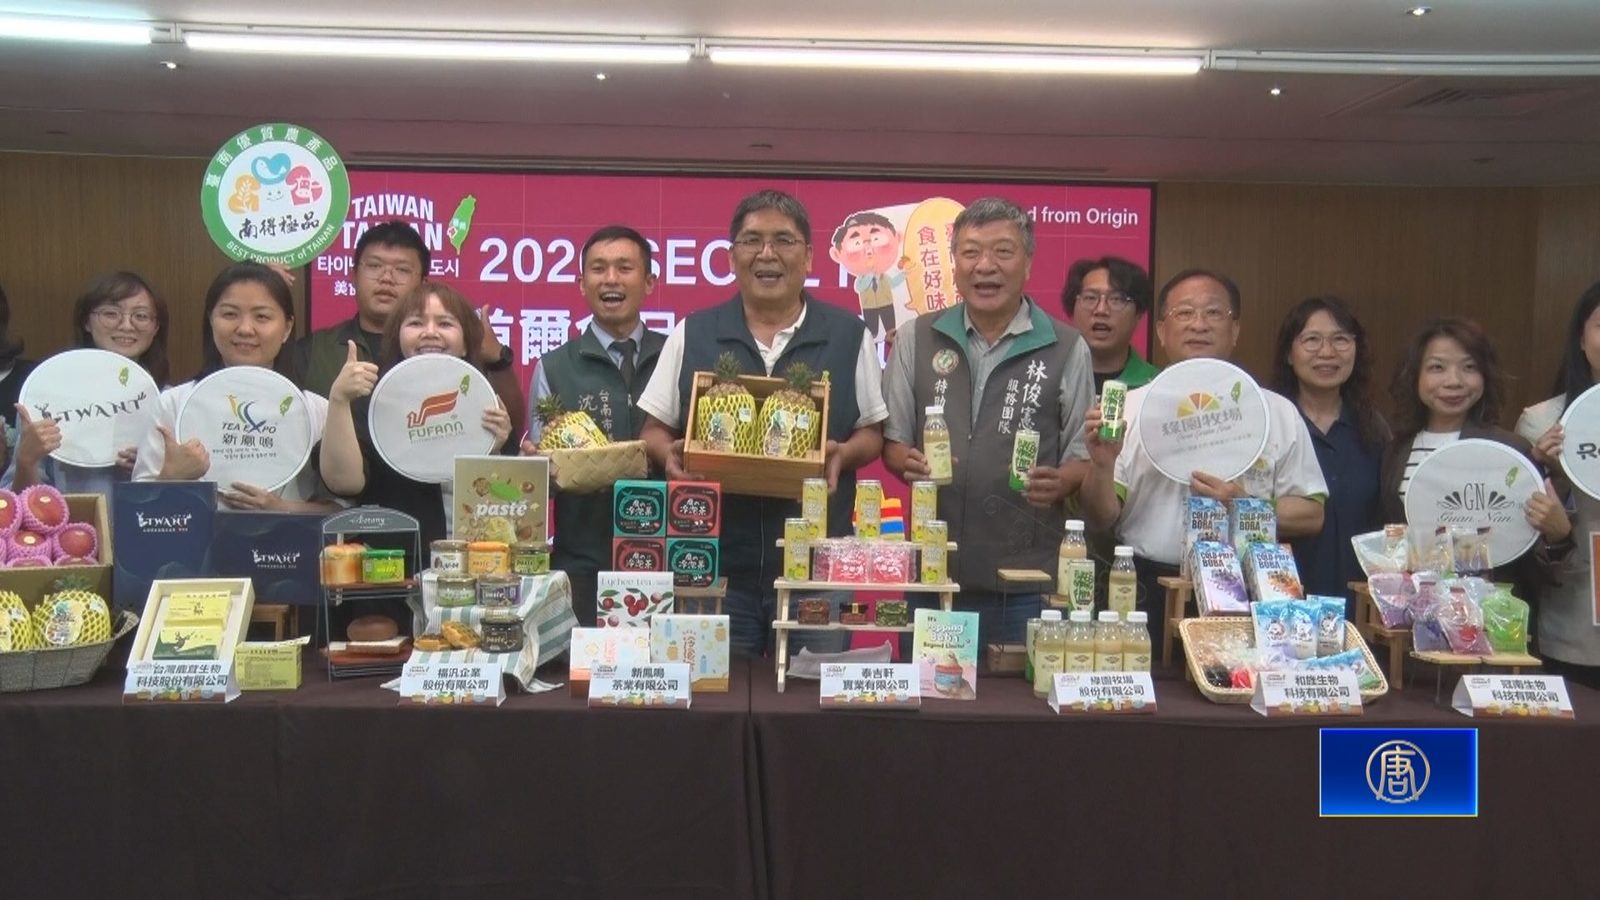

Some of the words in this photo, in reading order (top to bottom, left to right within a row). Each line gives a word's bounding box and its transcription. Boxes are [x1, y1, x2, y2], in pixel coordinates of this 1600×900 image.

[351, 194, 434, 221] TAIWAN
[1041, 206, 1081, 225] from
[1085, 207, 1139, 228] Origin
[226, 241, 249, 259] BEST
[297, 250, 307, 260] of
[316, 256, 354, 275] 타이
[479, 237, 585, 284] 202
[429, 259, 460, 278] 도시
[917, 225, 947, 311] 食在好味
[222, 422, 241, 432] TEA
[1463, 483, 1486, 511] GN
[1192, 511, 1226, 520] COLD-PREP
[1239, 512, 1273, 522] COLD-PREP
[1192, 520, 1213, 530] BOBA
[1239, 521, 1260, 531] BOBA
[1202, 559, 1225, 568] BOBA
[1258, 560, 1280, 569] BOBA
[437, 667, 481, 679] 福汎企業
[631, 666, 665, 679] 新鳳鳴
[861, 668, 895, 680] 泰吉軒
[136, 674, 229, 688] 科技股份有限公司
[422, 679, 489, 691] 股份有限公司
[612, 679, 679, 691] 茶業有限公司
[843, 679, 909, 691] 實業有限公司
[1500, 679, 1546, 691] 冠南生物
[1079, 685, 1145, 698] 股份有限公司
[1284, 686, 1350, 699] 科技有限公司
[1491, 691, 1560, 703] 科技有限公司
